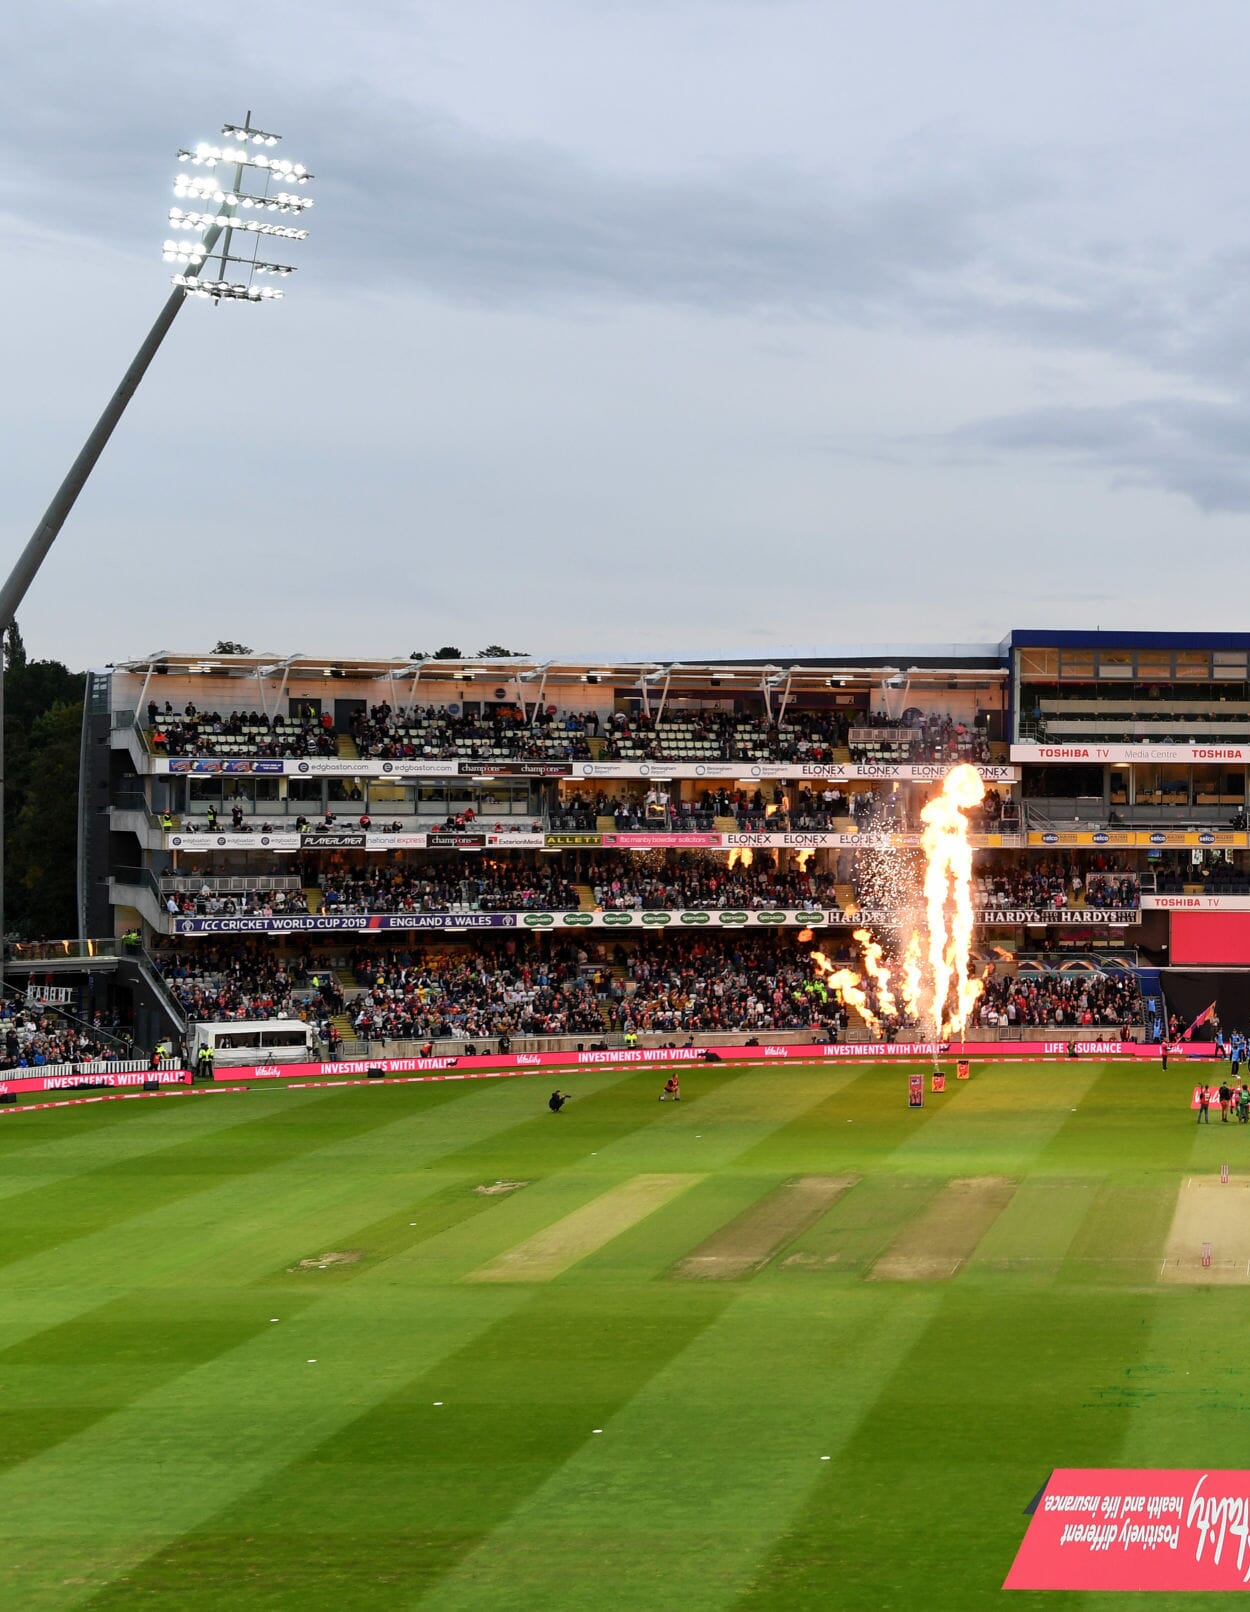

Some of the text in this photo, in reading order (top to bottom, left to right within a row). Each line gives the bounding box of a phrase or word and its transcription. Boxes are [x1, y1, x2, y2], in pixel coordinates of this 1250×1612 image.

[1038, 749, 1178, 758] TOSHIBA TV Media Centre
[1192, 749, 1242, 758] TOSHIBA
[311, 763, 369, 772] edgbaston.com
[394, 763, 452, 773] edgbaston.com
[802, 765, 845, 774] ELONEX
[857, 766, 900, 775] ELONEX
[728, 834, 772, 843] ELONEX
[784, 834, 828, 843] ELONEX
[1155, 898, 1220, 907] TOSHIBA TV
[1061, 911, 1117, 922] HARDYS
[201, 916, 492, 930] ICC CRICKET WORLD CUP 2019 ENGLAND & WALES
[764, 1046, 788, 1057] Vitality
[824, 1045, 885, 1056] INVESTMENTS
[887, 1044, 911, 1055] WITH
[1044, 1043, 1122, 1053] LIFE SURANCE
[516, 1054, 541, 1065] Vitality
[578, 1050, 642, 1062] INVESTMENTS
[643, 1049, 669, 1060] WITH
[390, 1058, 415, 1070] WITH
[255, 1065, 281, 1077] Vitality
[117, 1074, 144, 1087] WITH
[1044, 1495, 1184, 1519] health and life insurance.
[1060, 1518, 1179, 1551] Positively different
